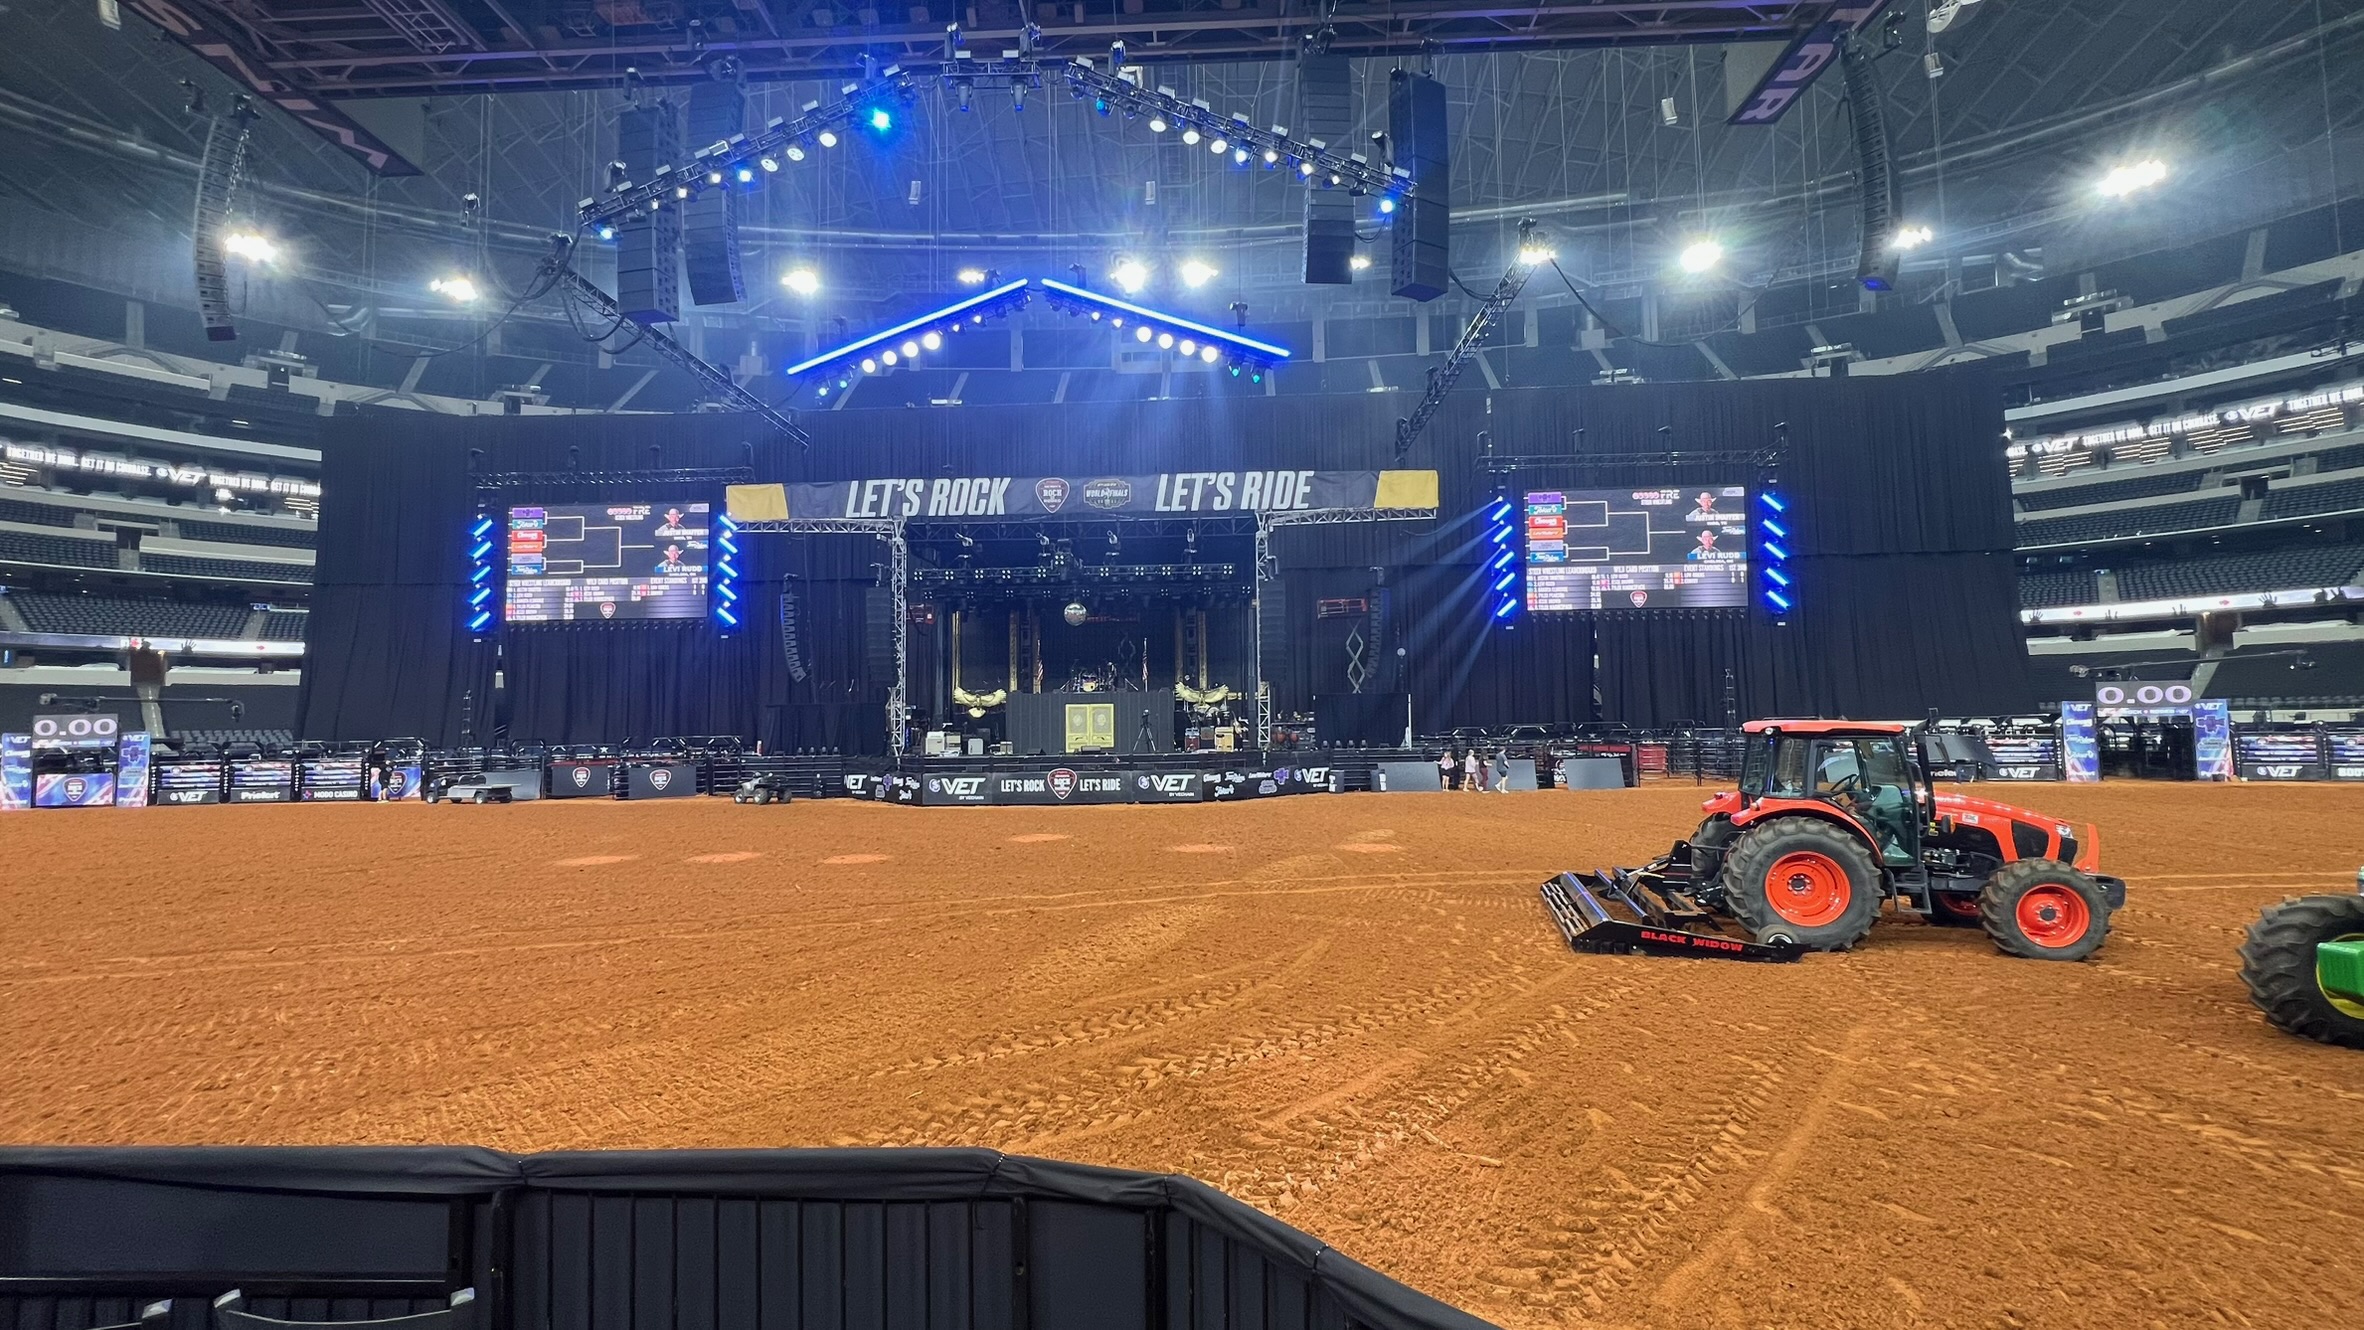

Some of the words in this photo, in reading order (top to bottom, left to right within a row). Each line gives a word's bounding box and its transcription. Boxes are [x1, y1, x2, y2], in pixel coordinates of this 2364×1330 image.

[2237, 402, 2284, 419] VET
[2042, 436, 2079, 452] VET
[168, 468, 207, 485] VET
[845, 478, 924, 518] LET'S
[928, 477, 1011, 517] ROCK
[1155, 472, 1235, 512] LET'S
[1240, 470, 1314, 510] RIDE
[2097, 685, 2192, 704] 0.00
[2070, 703, 2092, 712] VET
[2200, 702, 2223, 711] VET
[34, 718, 118, 736] 0.00
[1302, 767, 1330, 783] VET
[2007, 767, 2041, 778] VET
[2266, 765, 2303, 777] VET
[940, 777, 987, 795] VET
[1001, 779, 1023, 793] LET'S
[1023, 778, 1045, 792] ROCK
[1079, 778, 1101, 792] LET'S
[1102, 778, 1121, 791] RIDE
[1150, 774, 1196, 791] VET
[178, 791, 209, 802] VET
[334, 789, 358, 798] CASINO
[1641, 930, 1686, 944] BLACK
[1692, 938, 1744, 951] WIDOW
